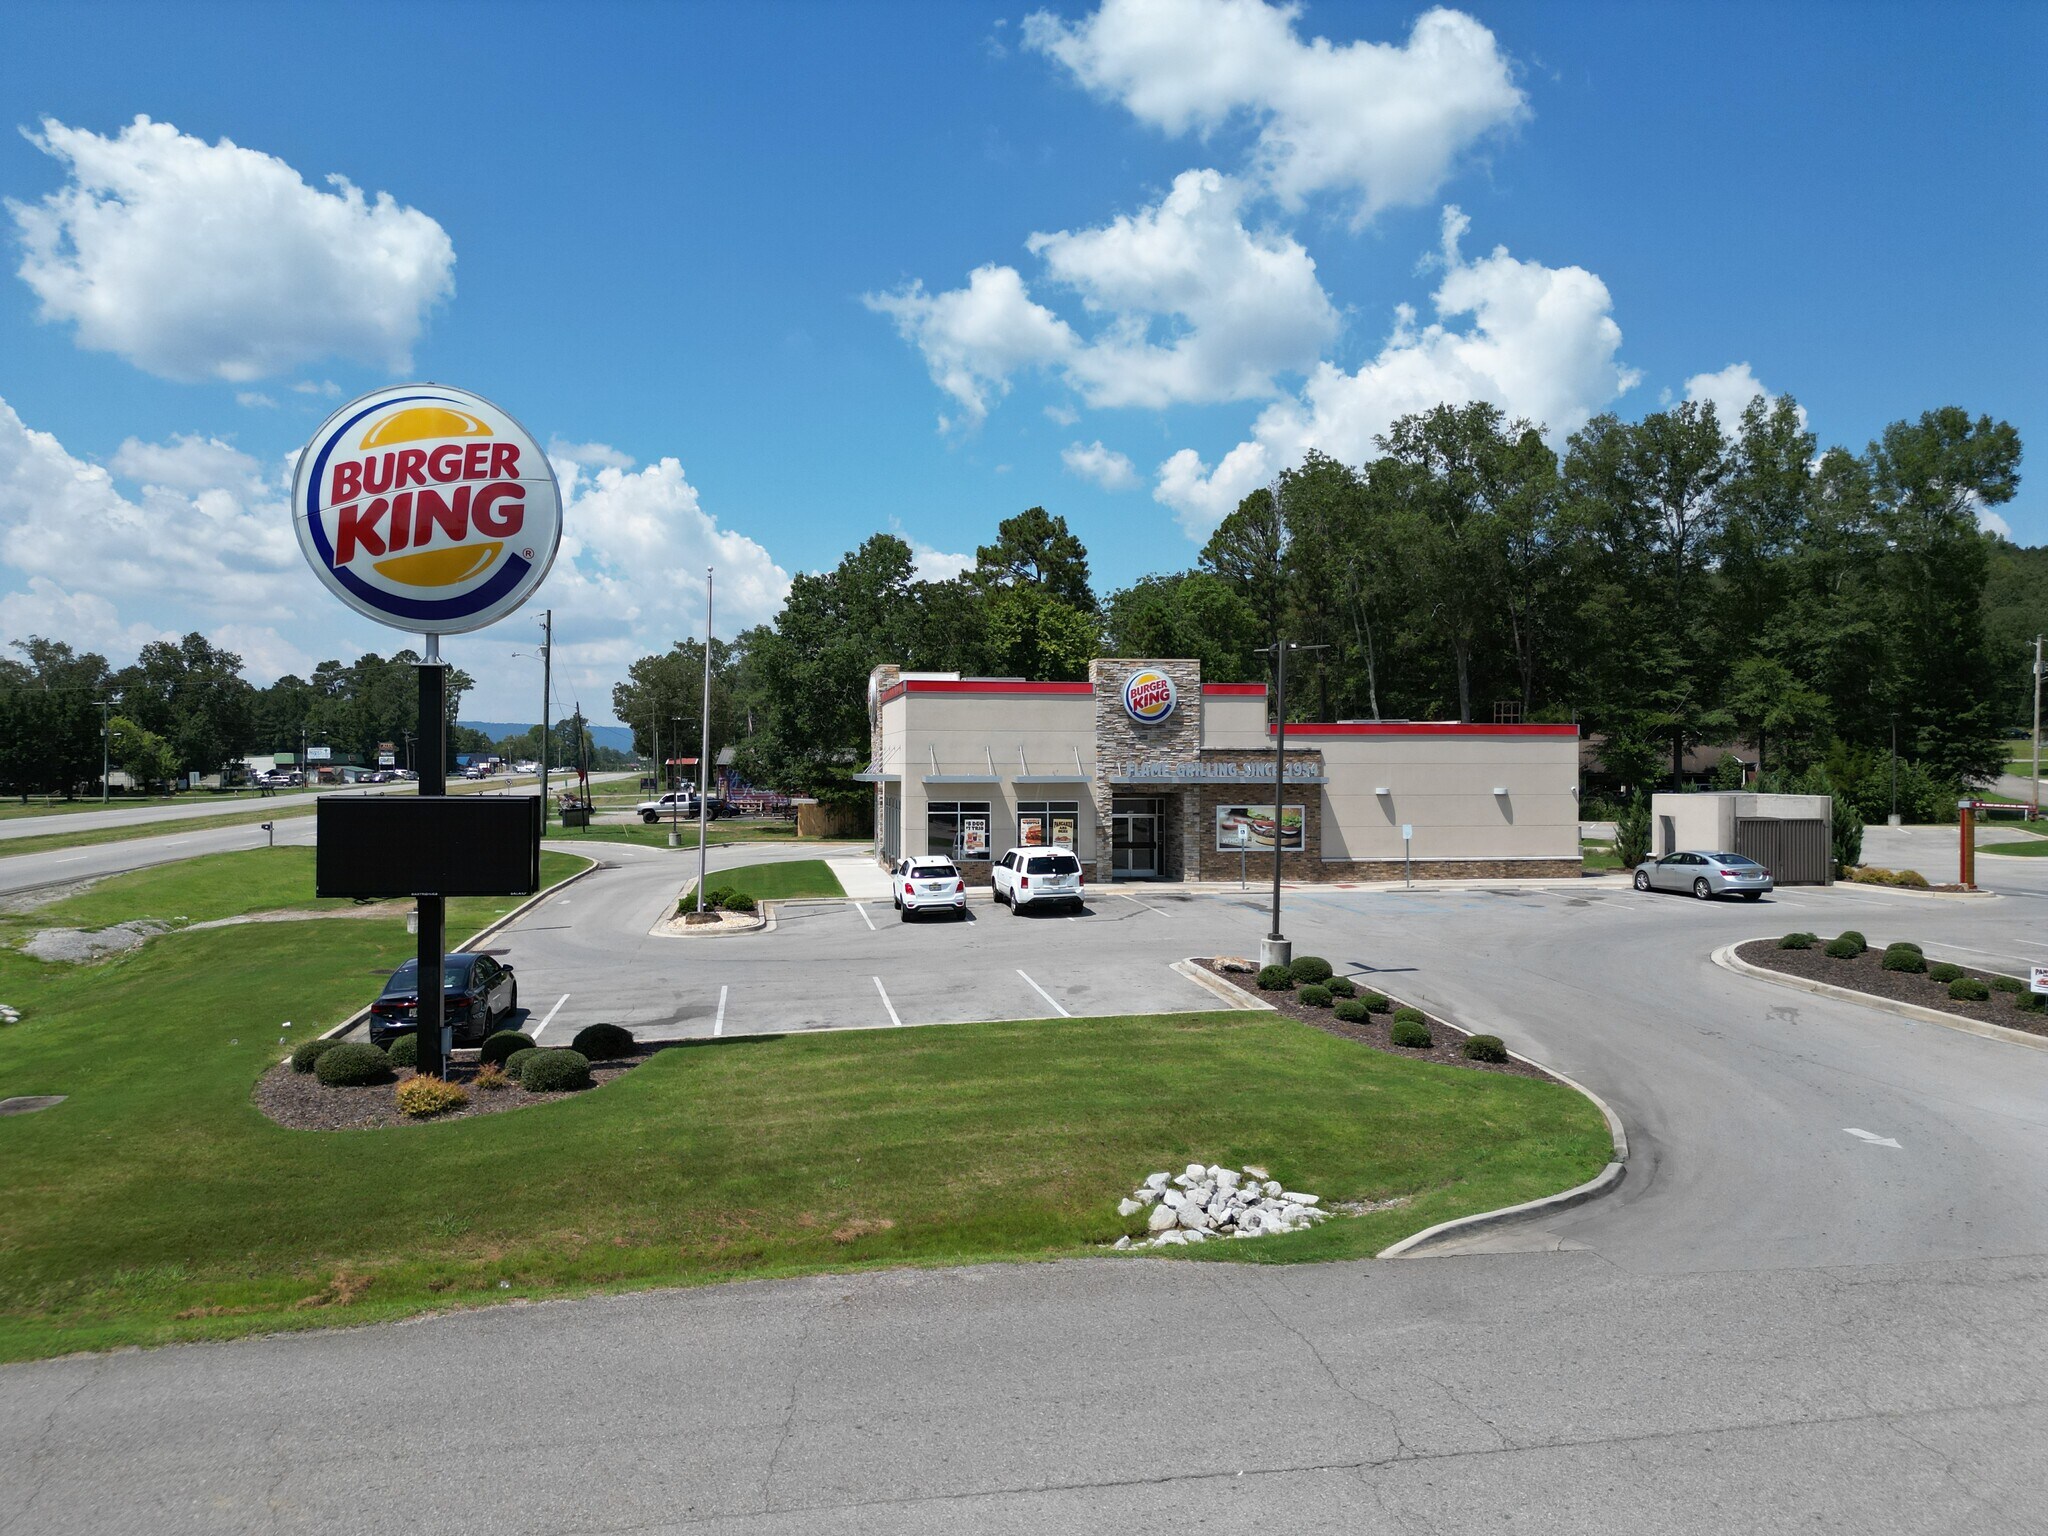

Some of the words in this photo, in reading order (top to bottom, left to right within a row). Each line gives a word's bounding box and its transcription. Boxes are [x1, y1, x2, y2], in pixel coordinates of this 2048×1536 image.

[331, 443, 520, 506] BURGER
[334, 482, 526, 567] KING
[1130, 679, 1167, 699] BURGER
[1133, 688, 1170, 712] KING
[1126, 761, 1170, 777] FLAME
[1176, 762, 1236, 777] GRILLING
[1243, 762, 1278, 777] SINCE
[1285, 762, 1318, 778] 1954
